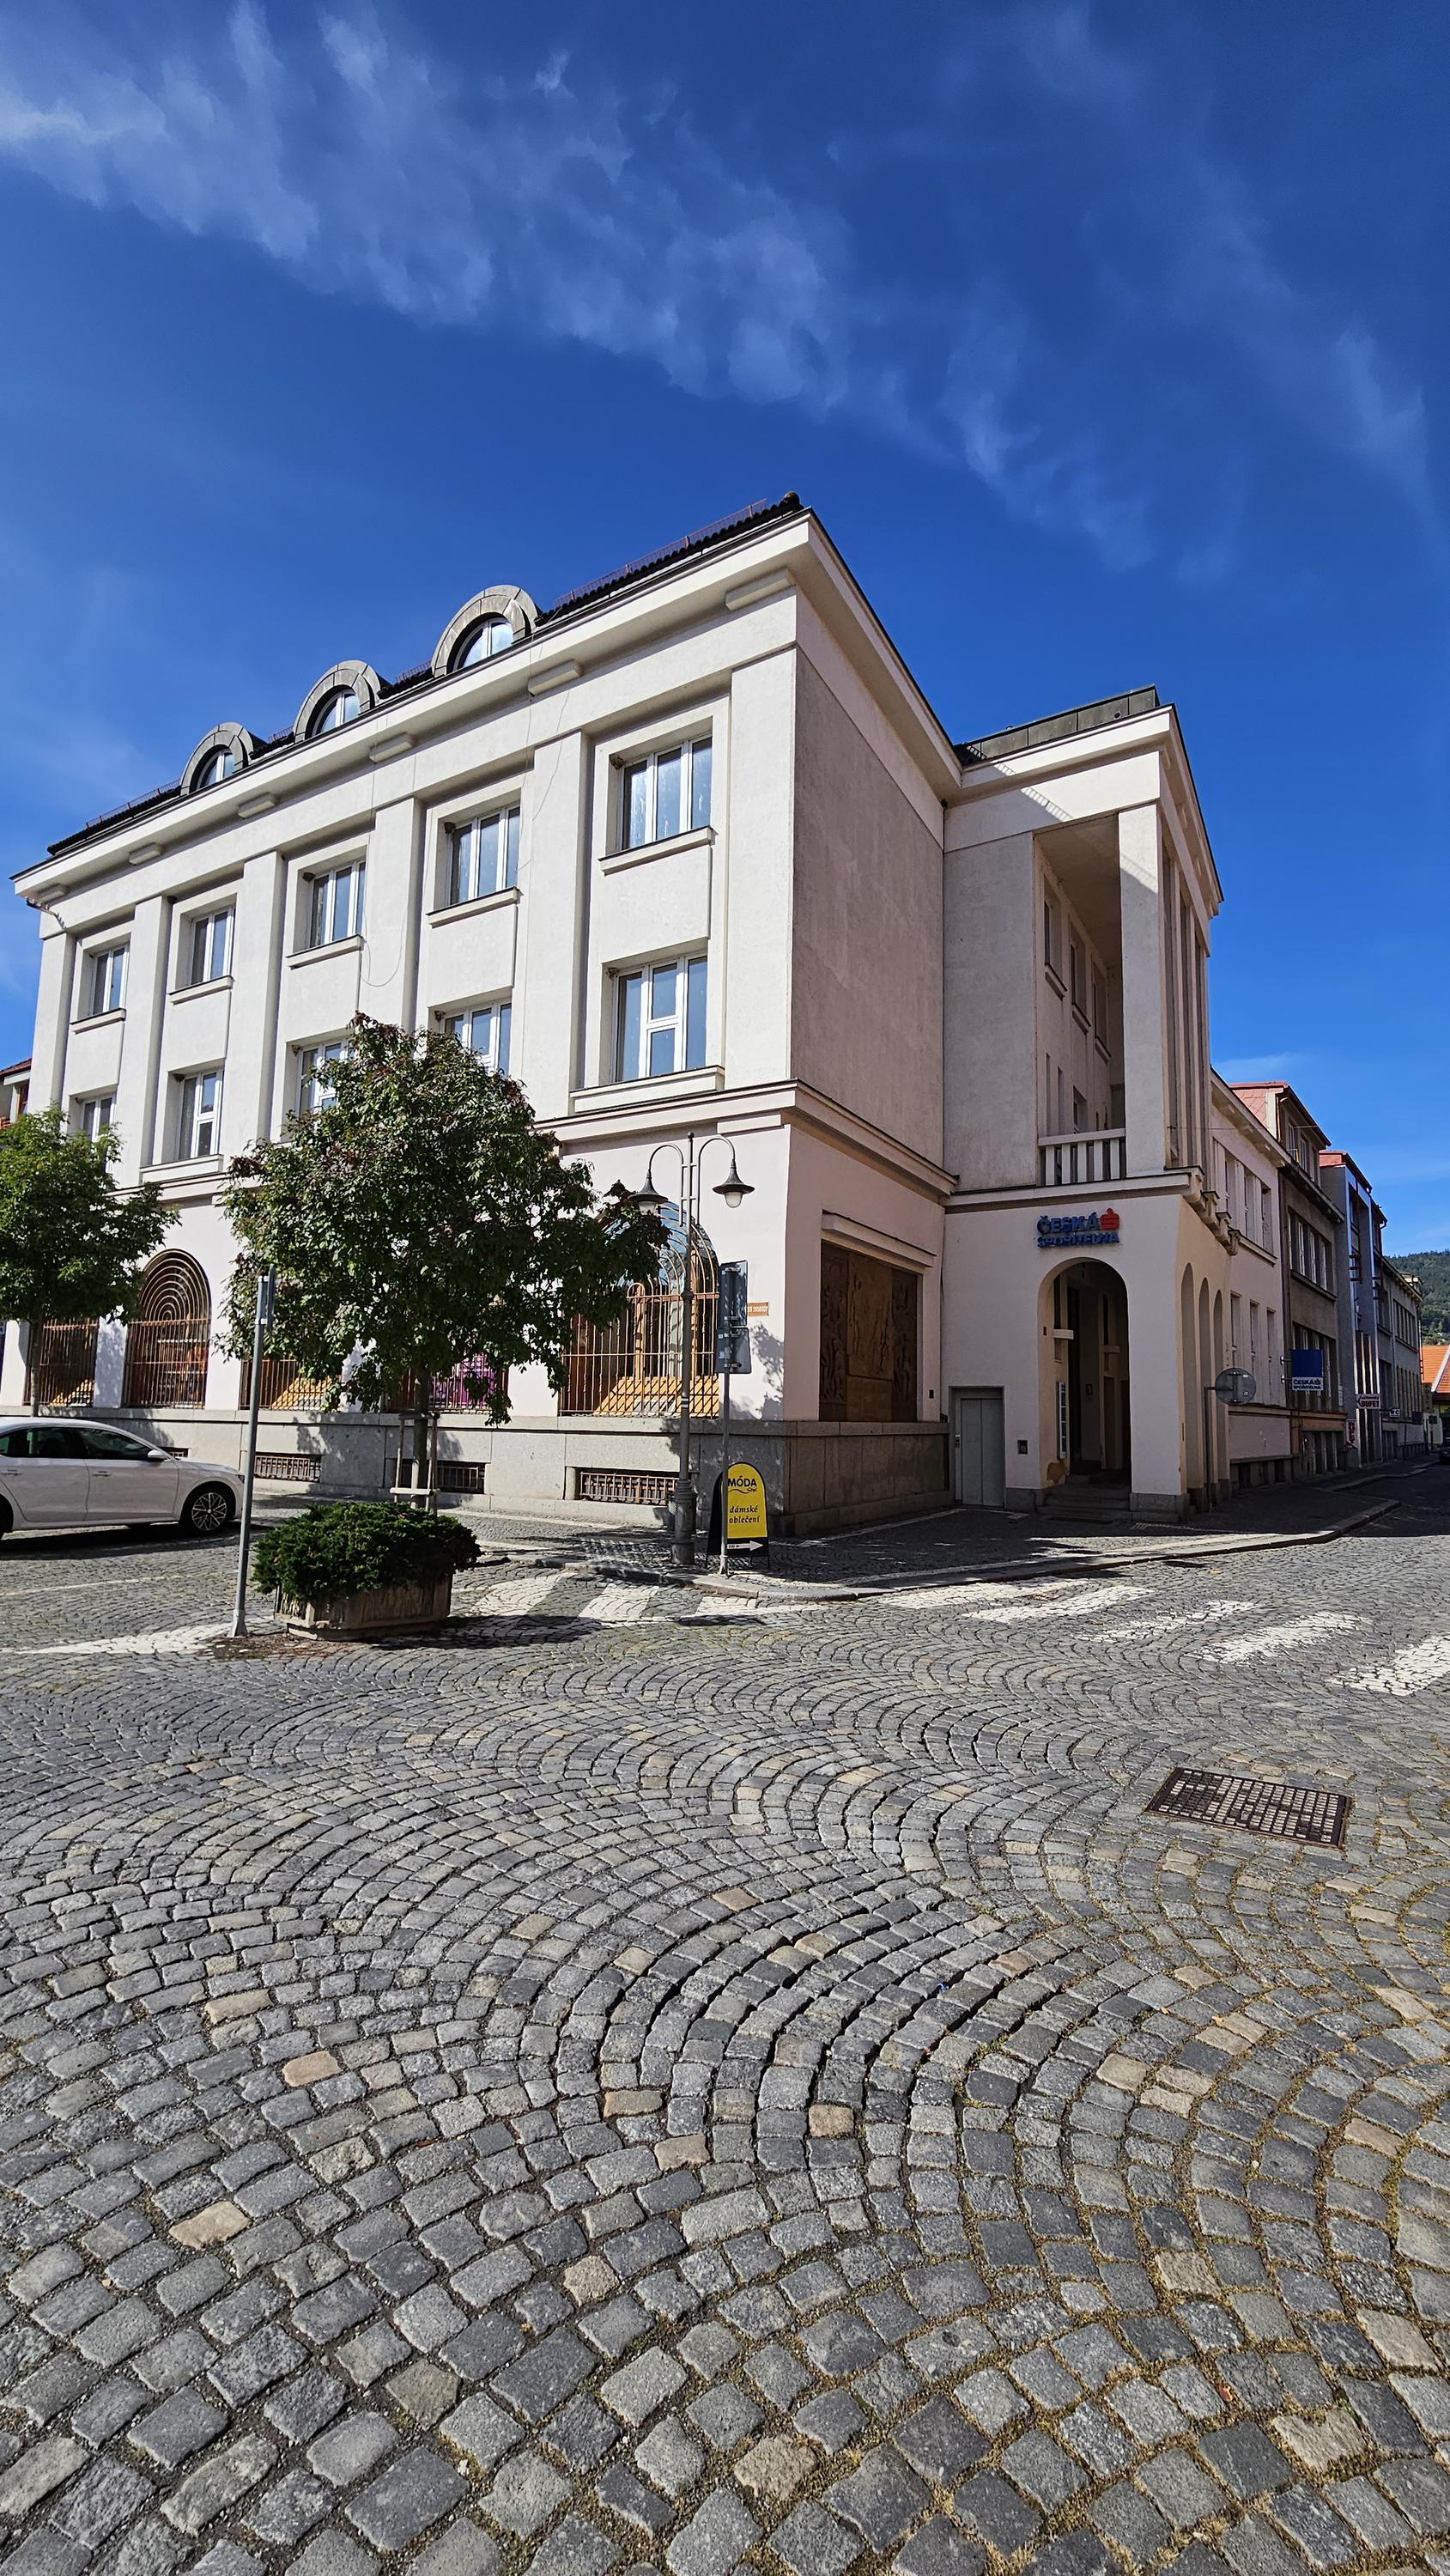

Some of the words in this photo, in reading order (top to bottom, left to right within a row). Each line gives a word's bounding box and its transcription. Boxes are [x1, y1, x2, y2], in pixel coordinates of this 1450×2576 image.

[1037, 1212, 1100, 1233] ČESKÁ
[1037, 1232, 1119, 1248] SPOŘITELNA
[728, 1476, 756, 1486] MÓDA
